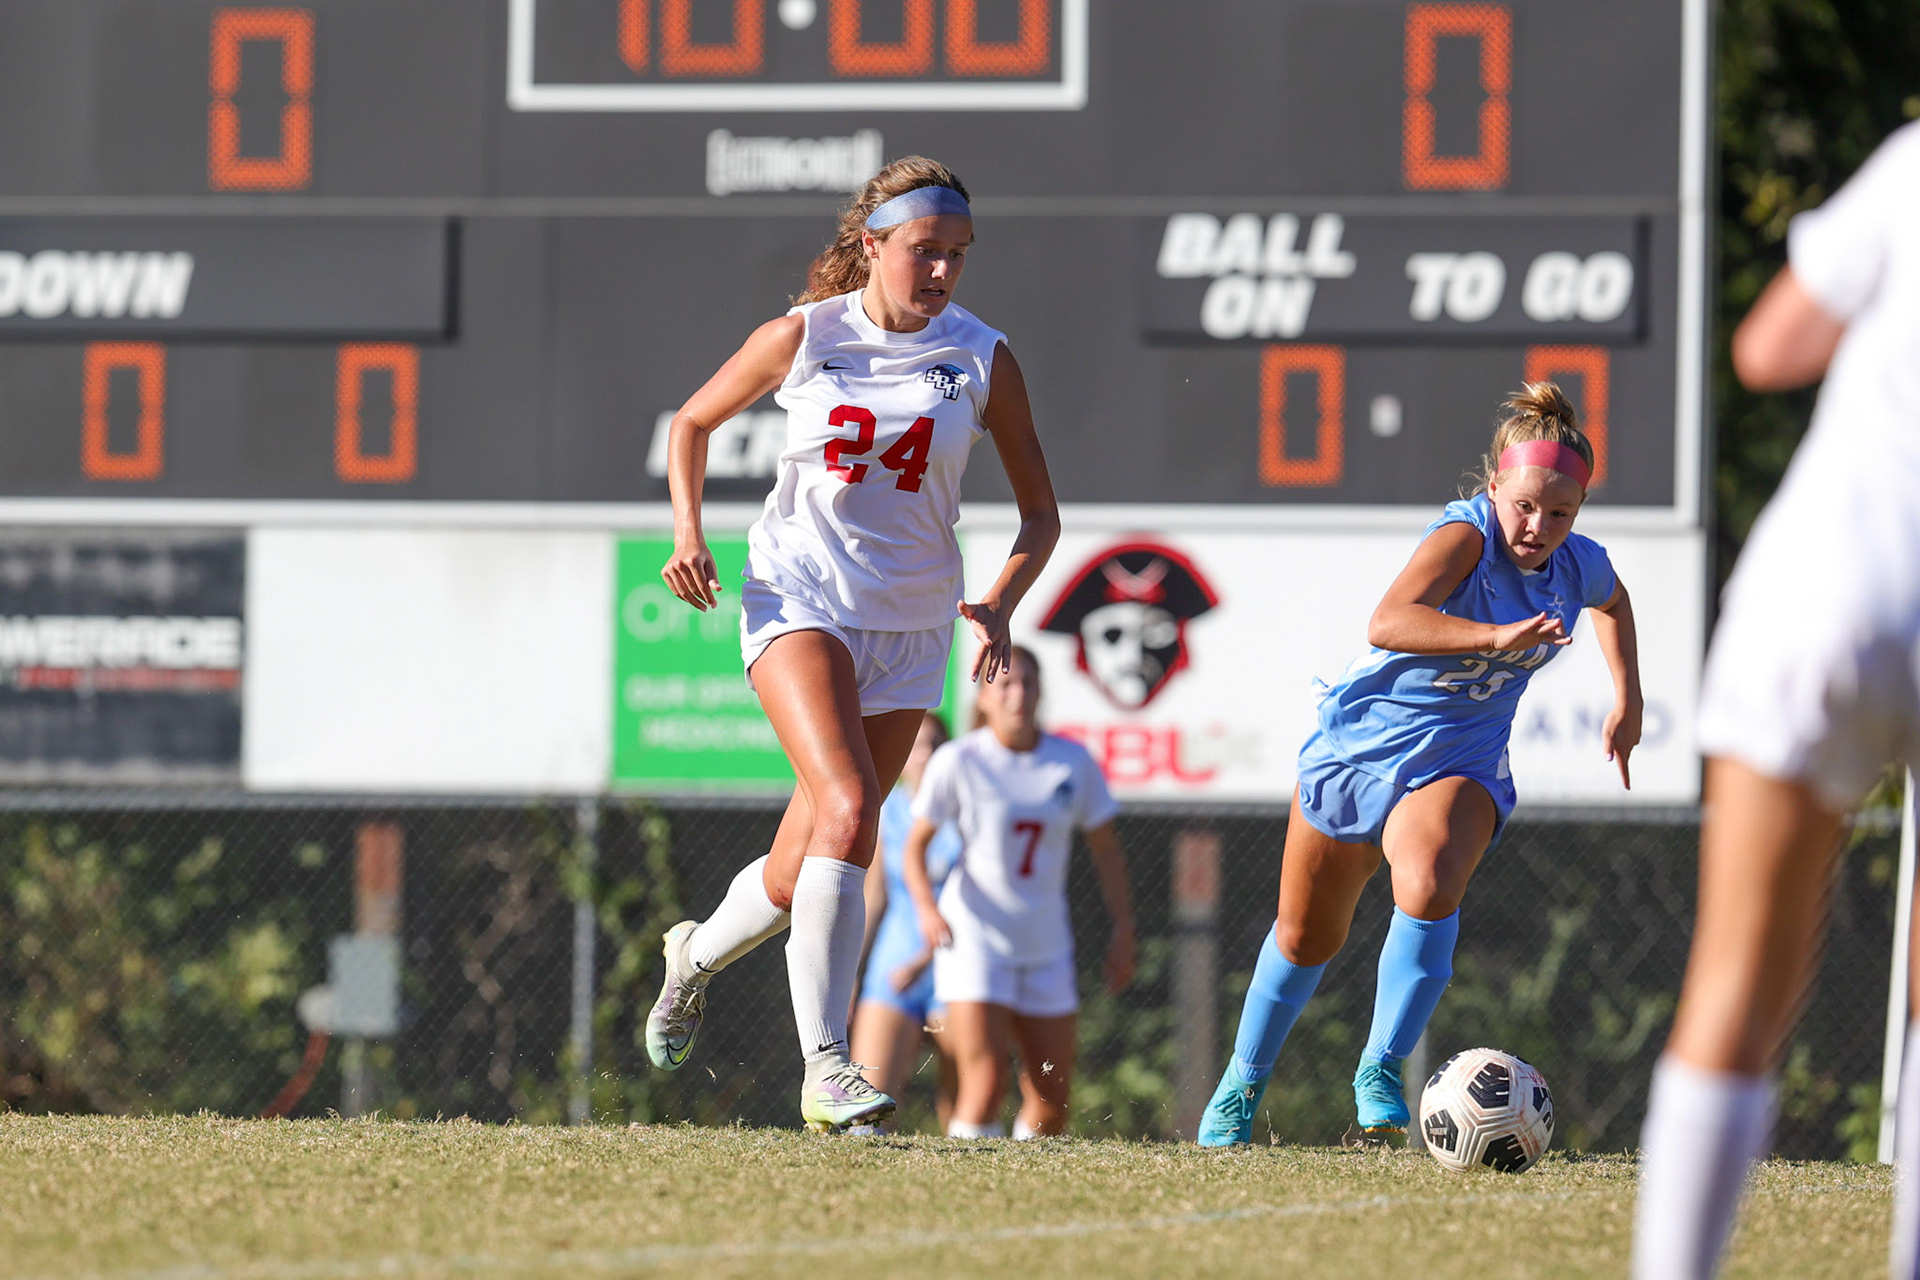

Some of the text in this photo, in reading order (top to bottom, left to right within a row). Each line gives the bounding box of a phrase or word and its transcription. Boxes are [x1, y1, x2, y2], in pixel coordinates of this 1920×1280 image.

[208, 8, 314, 190] 0
[1403, 4, 1512, 191] 0
[1157, 213, 1357, 278] BALL
[1200, 277, 1316, 339] ON
[1405, 252, 1633, 322] TO GO
[82, 341, 165, 482] 0
[334, 342, 419, 484] 0
[925, 368, 961, 400] SBA
[1259, 343, 1345, 488] 0
[824, 404, 935, 493] 24
[1432, 658, 1516, 702] 25
[1013, 821, 1044, 876] 7
